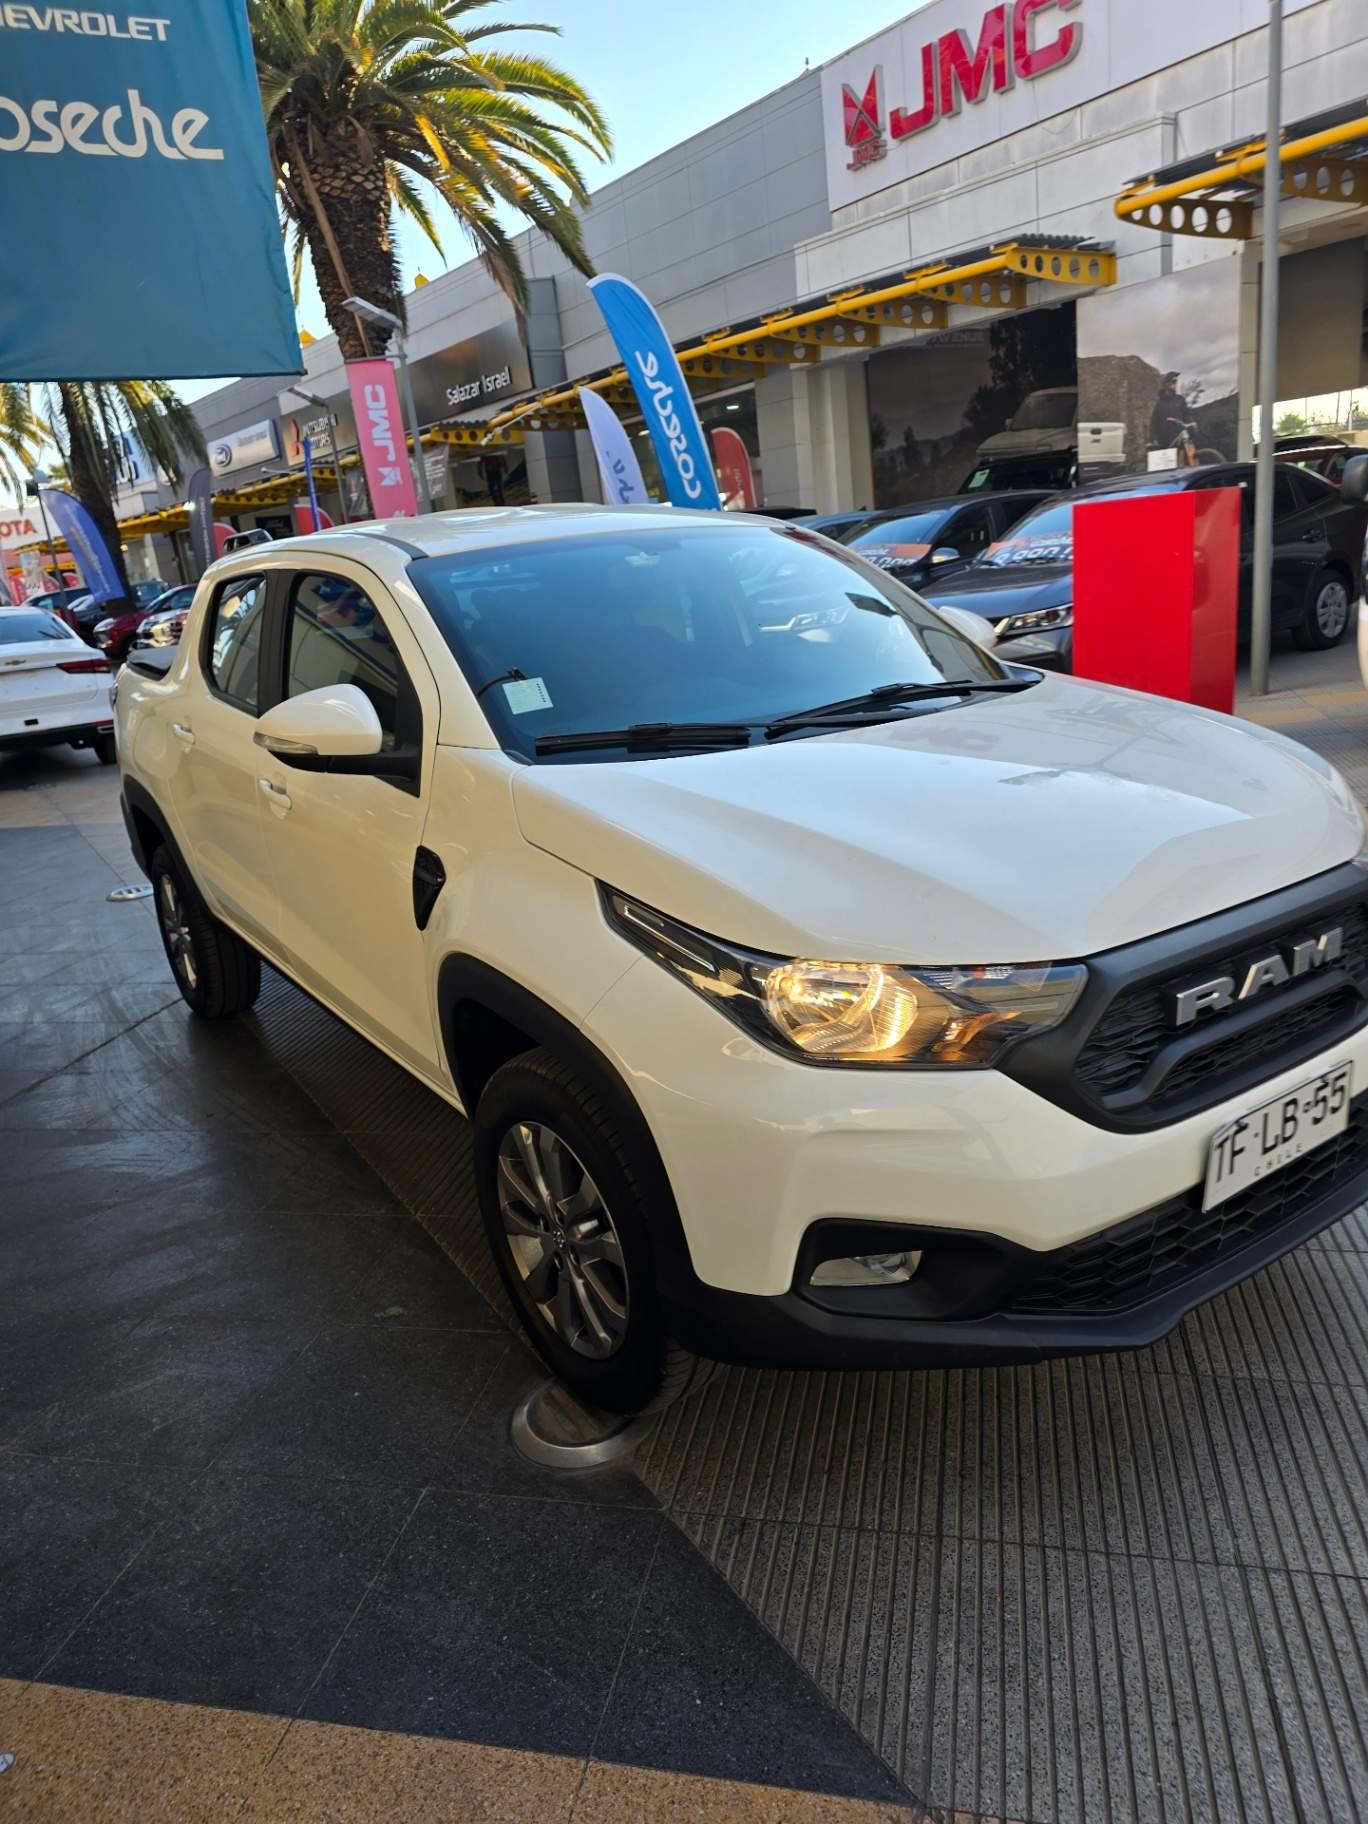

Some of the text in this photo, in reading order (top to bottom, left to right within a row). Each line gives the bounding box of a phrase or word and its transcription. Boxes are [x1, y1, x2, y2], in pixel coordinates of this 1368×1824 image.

[0, 4, 170, 41] EVROLET
[889, 0, 1083, 141] JMC
[446, 366, 512, 405] Salazar Israel
[364, 384, 396, 461] JMC
[0, 519, 37, 537] OTA
[1176, 927, 1342, 1026] RAM
[1254, 1143, 1303, 1177] CHILE
